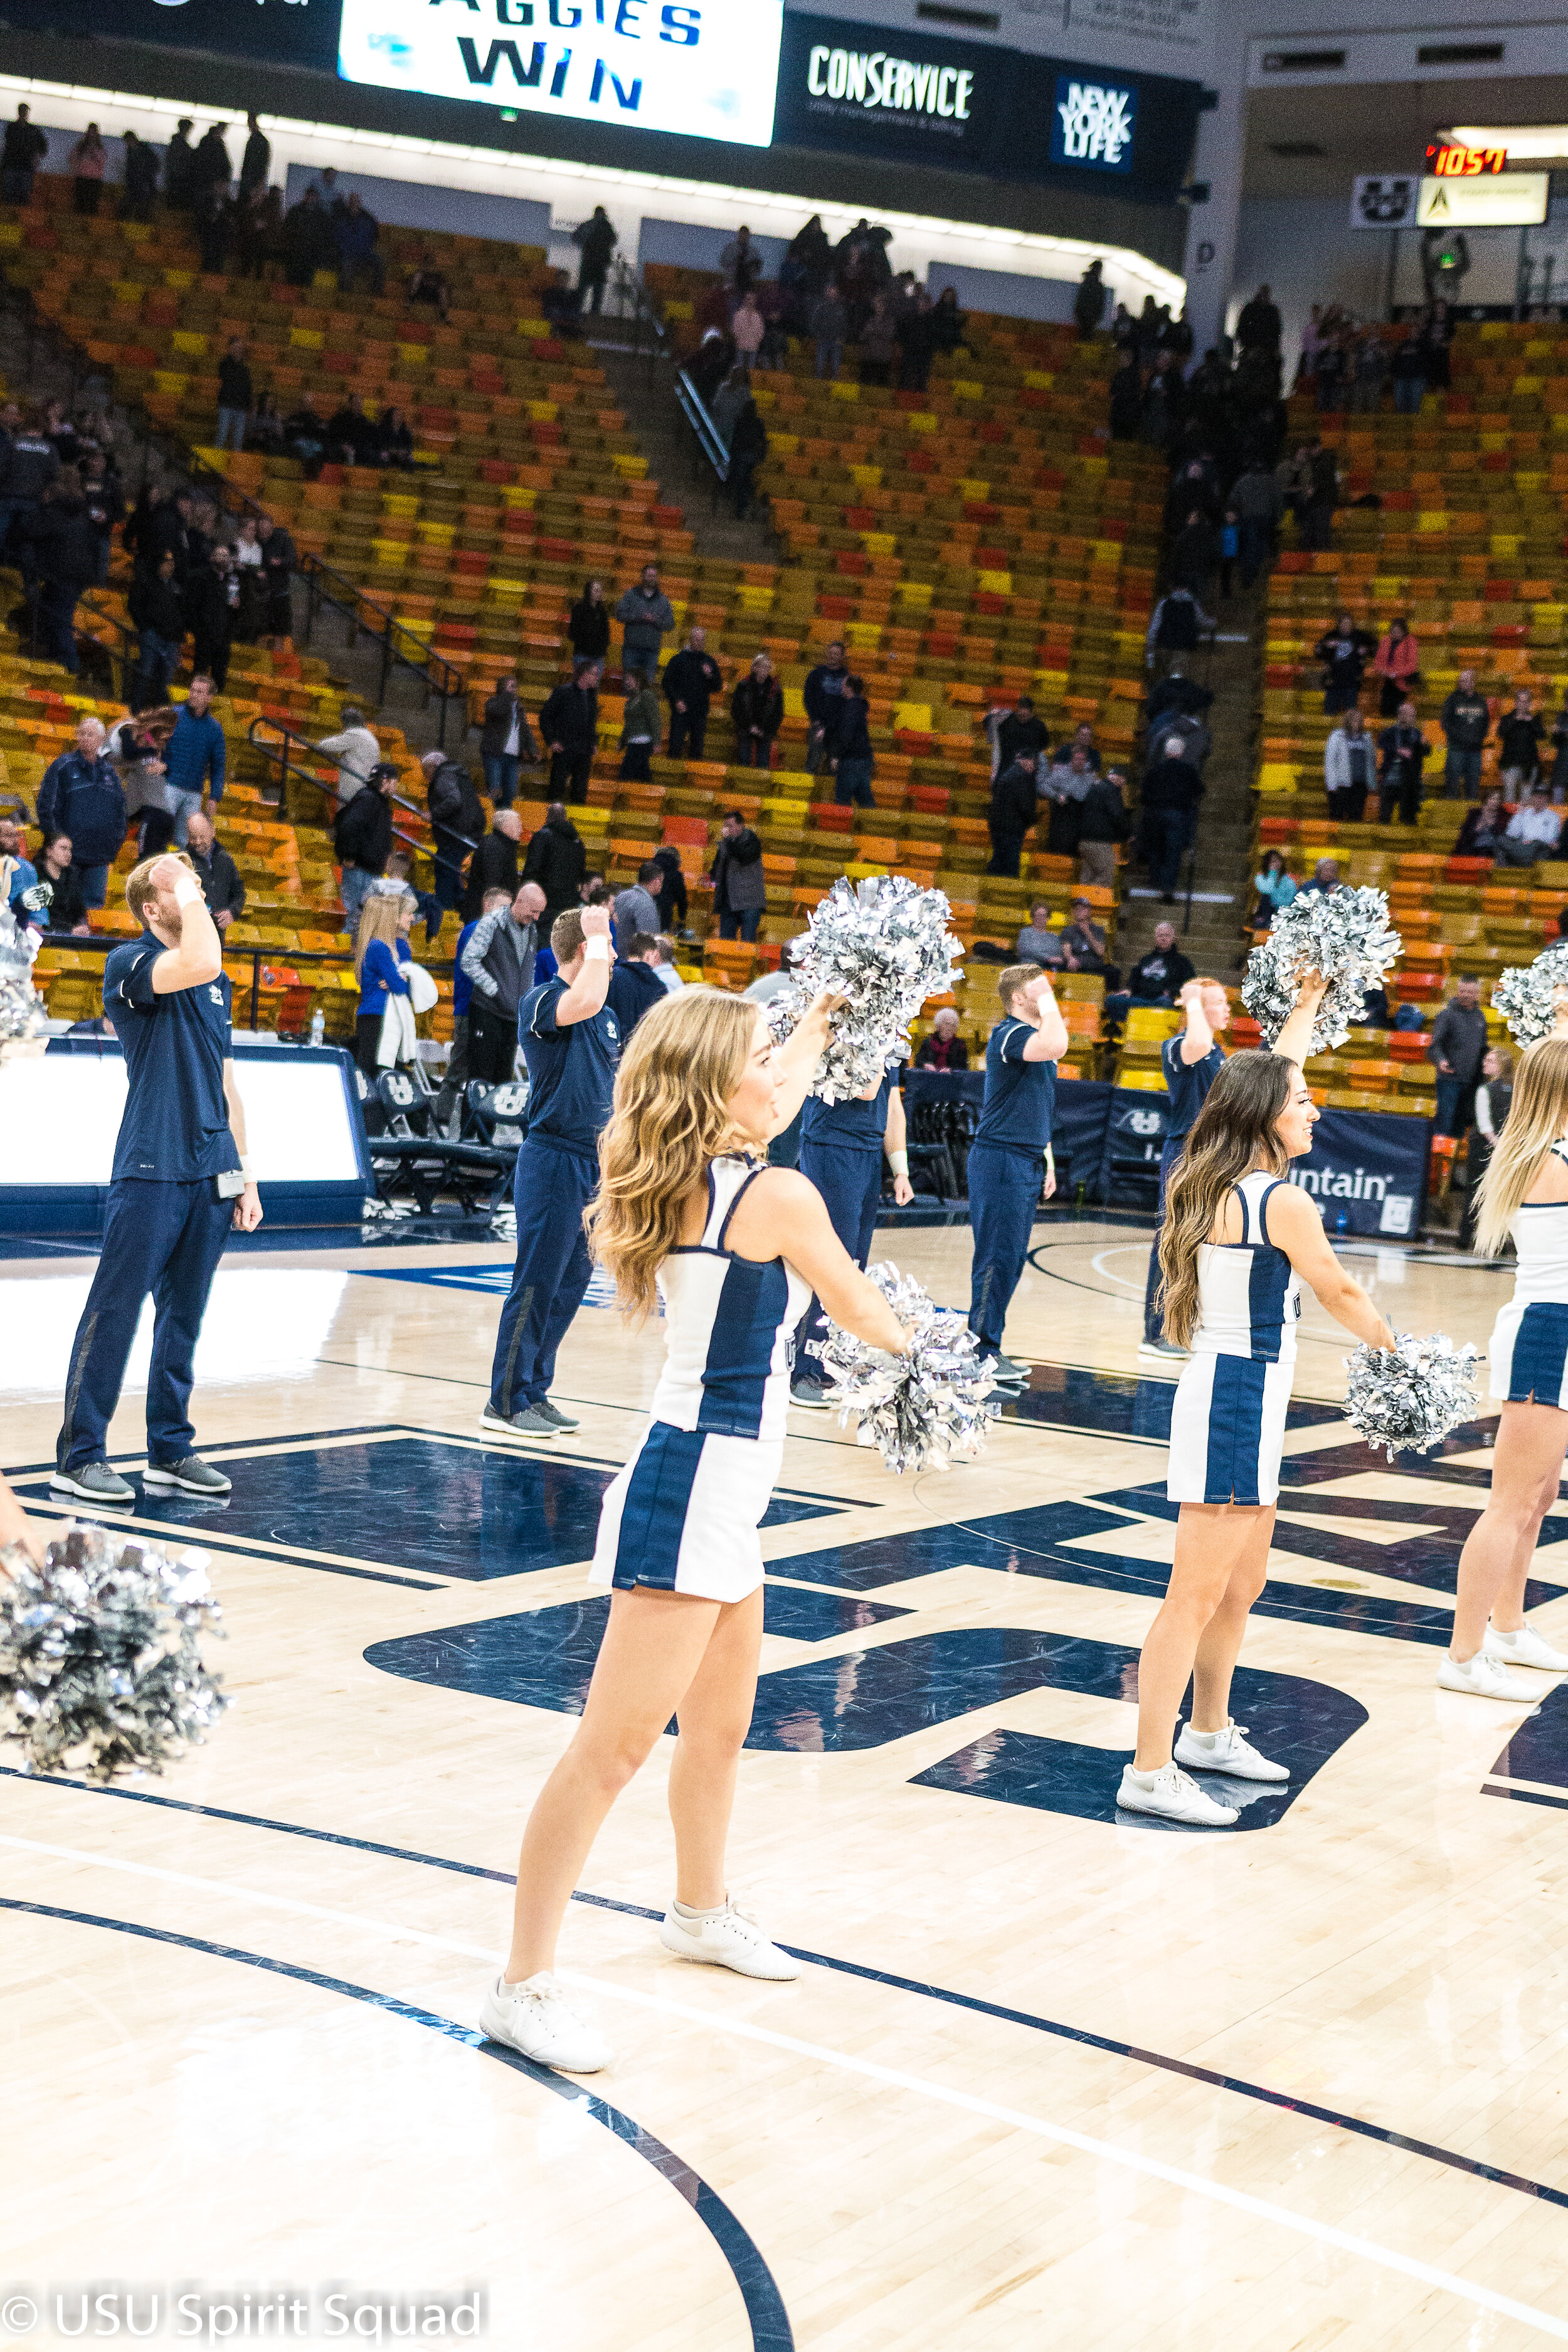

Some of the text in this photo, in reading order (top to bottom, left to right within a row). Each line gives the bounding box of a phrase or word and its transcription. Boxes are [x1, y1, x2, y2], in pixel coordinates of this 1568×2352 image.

[428, 0, 701, 46] GGIES
[457, 36, 642, 110] WIN
[1068, 82, 1129, 116] NEW
[1057, 102, 1132, 144] YORK
[1064, 129, 1121, 163] LIFE
